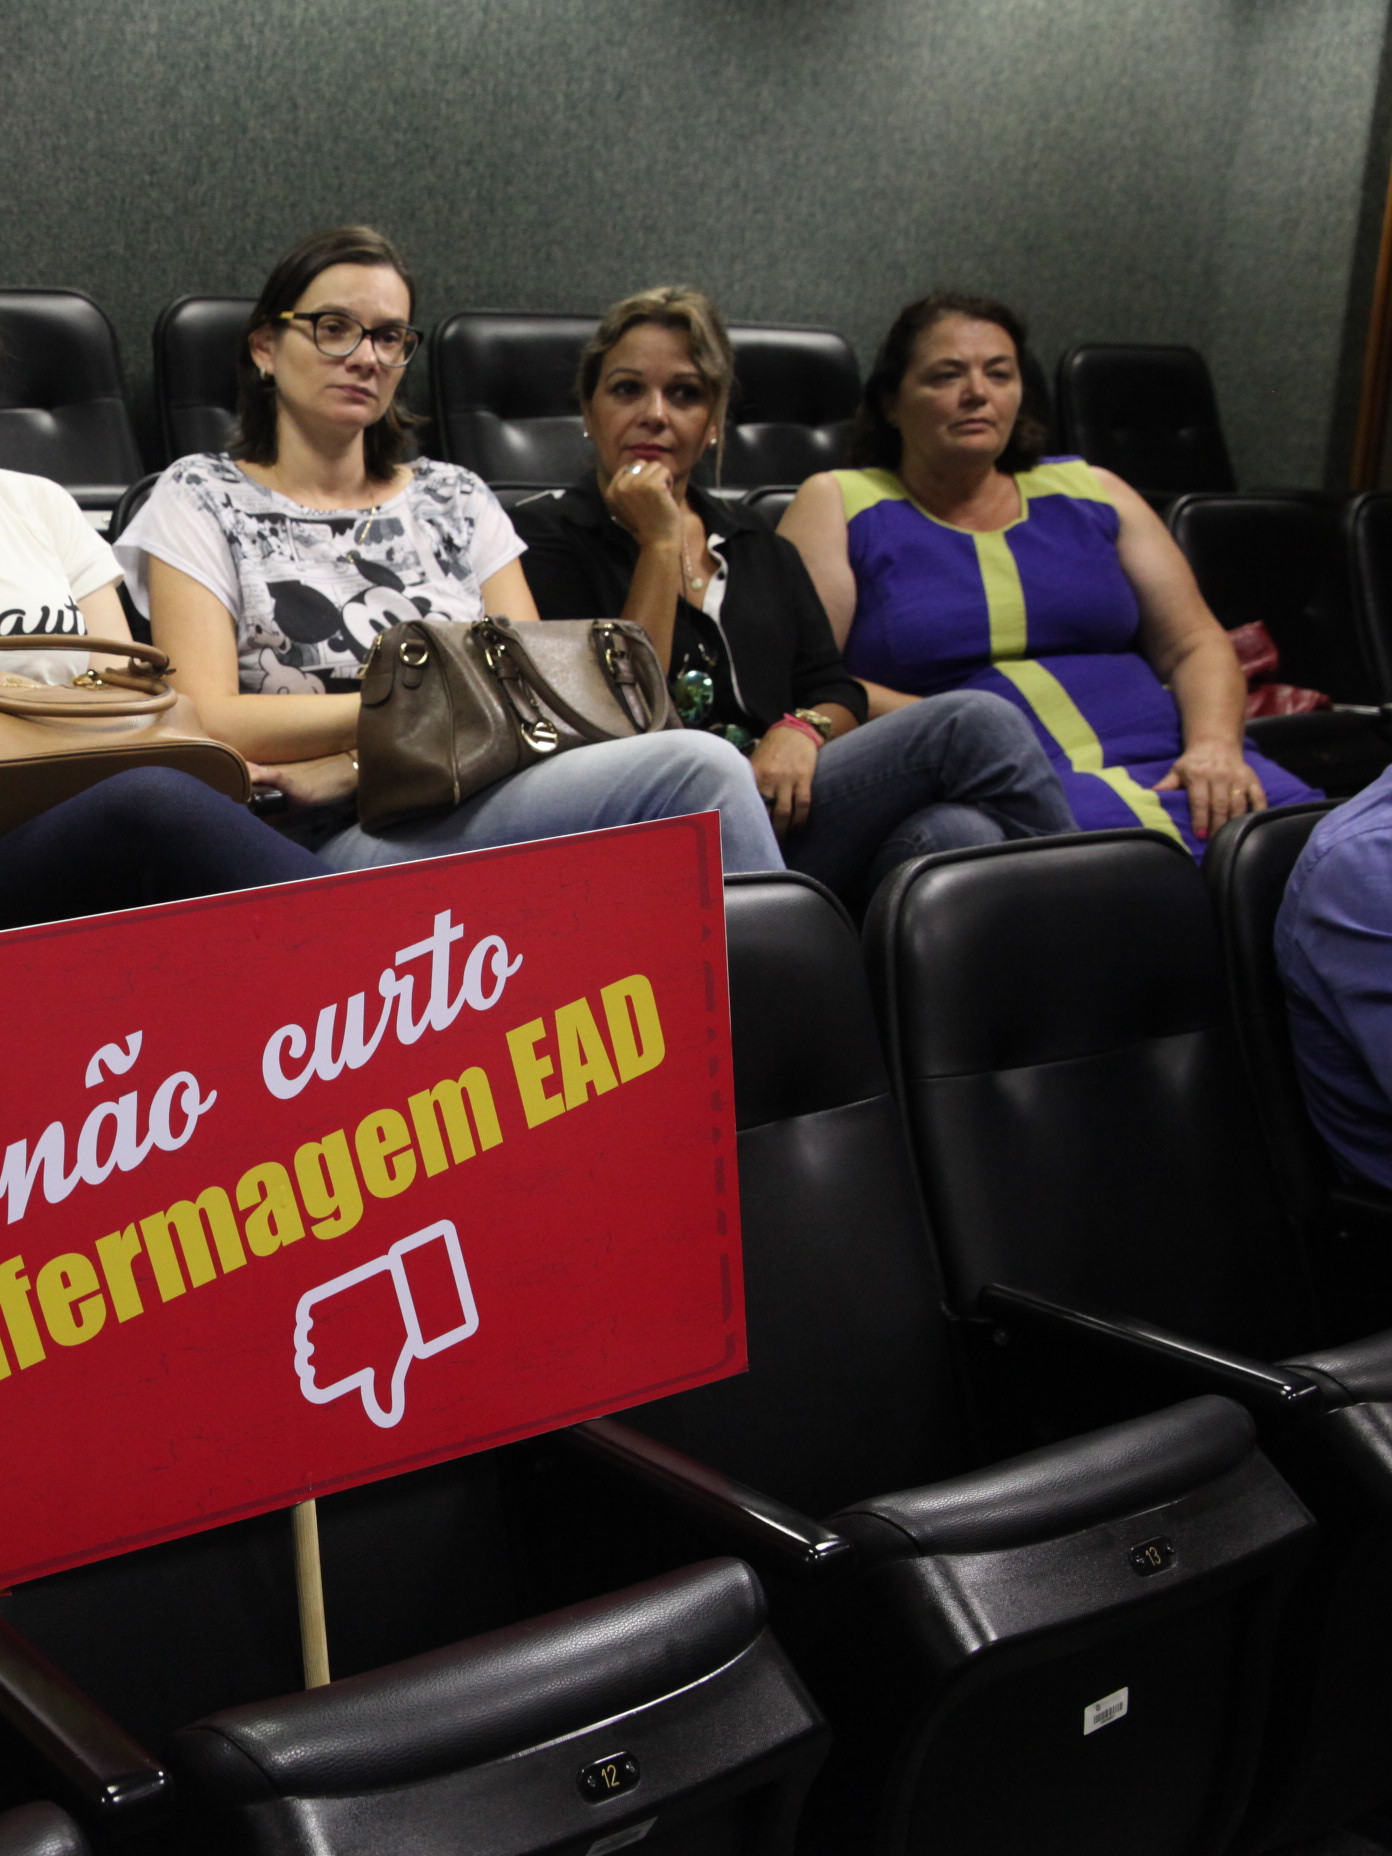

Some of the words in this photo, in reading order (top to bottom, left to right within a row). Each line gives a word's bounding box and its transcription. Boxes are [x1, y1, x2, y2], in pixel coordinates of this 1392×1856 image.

[261, 908, 524, 1100] curto
[506, 974, 666, 1129] EAD
[1144, 1545, 1162, 1567] 13
[601, 1764, 621, 1789] 12
